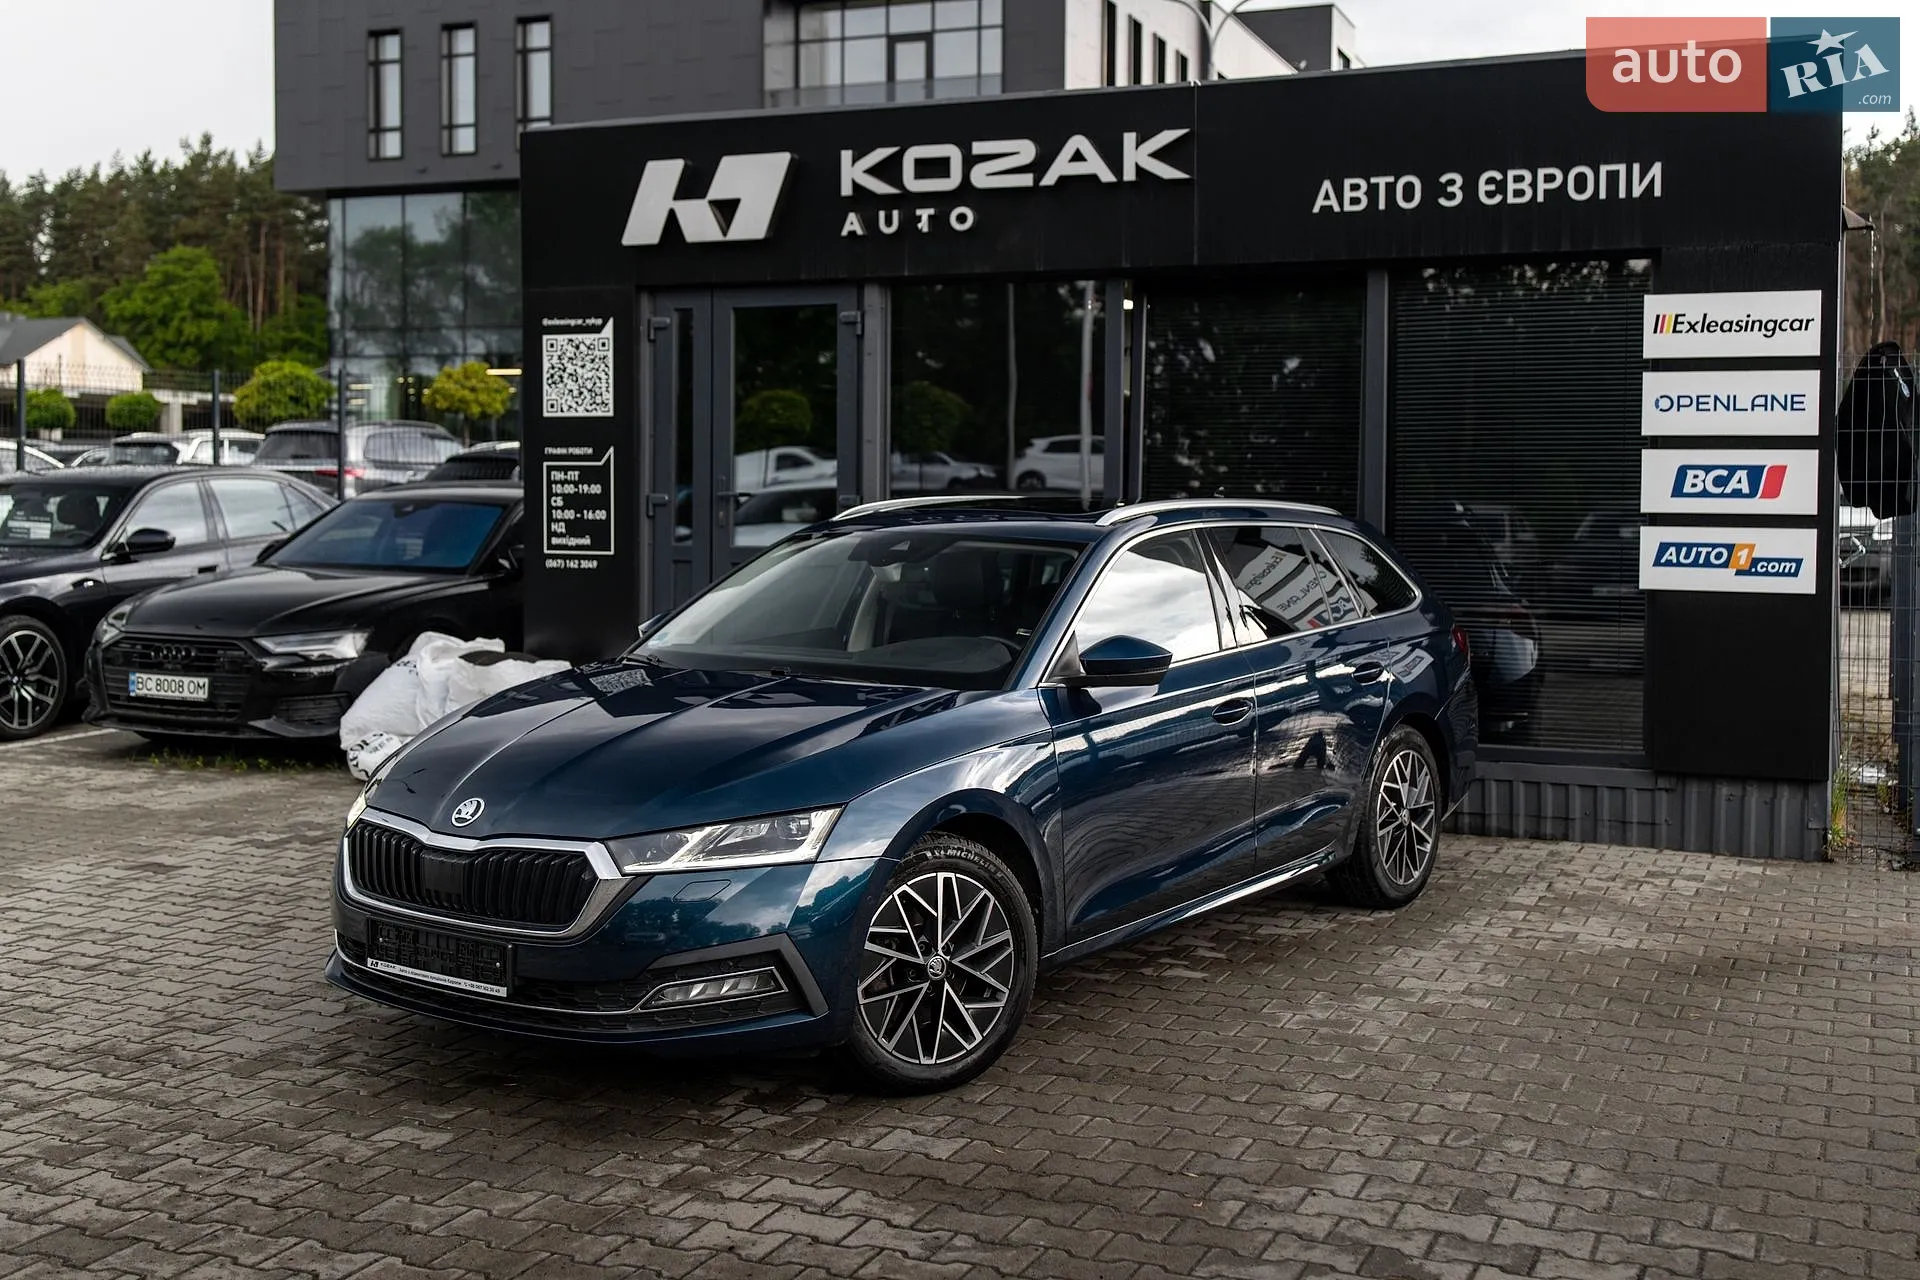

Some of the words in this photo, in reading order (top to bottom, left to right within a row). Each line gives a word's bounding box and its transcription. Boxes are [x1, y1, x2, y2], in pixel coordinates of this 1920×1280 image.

[840, 128, 1191, 196] KOZAK
[1312, 174, 1422, 213] АВТО
[1437, 172, 1464, 207] З
[1478, 161, 1663, 205] ЄВРОПИ
[840, 205, 975, 236] AUTO
[1671, 312, 1815, 338] Exleasingcar
[1654, 393, 1807, 413] OPENLANE
[551, 470, 580, 481] ПН-ПТ
[1682, 468, 1750, 494] BCA
[550, 496, 564, 507] СБ
[551, 509, 575, 520] 10:00
[583, 509, 607, 520] 16:00
[551, 521, 567, 534] НД
[545, 558, 565, 569] (067)
[566, 559, 579, 569] 162
[136, 676, 152, 692] BC
[155, 678, 185, 694] 8008
[187, 680, 206, 696] OM
[946, 849, 997, 875] MICHELIN
